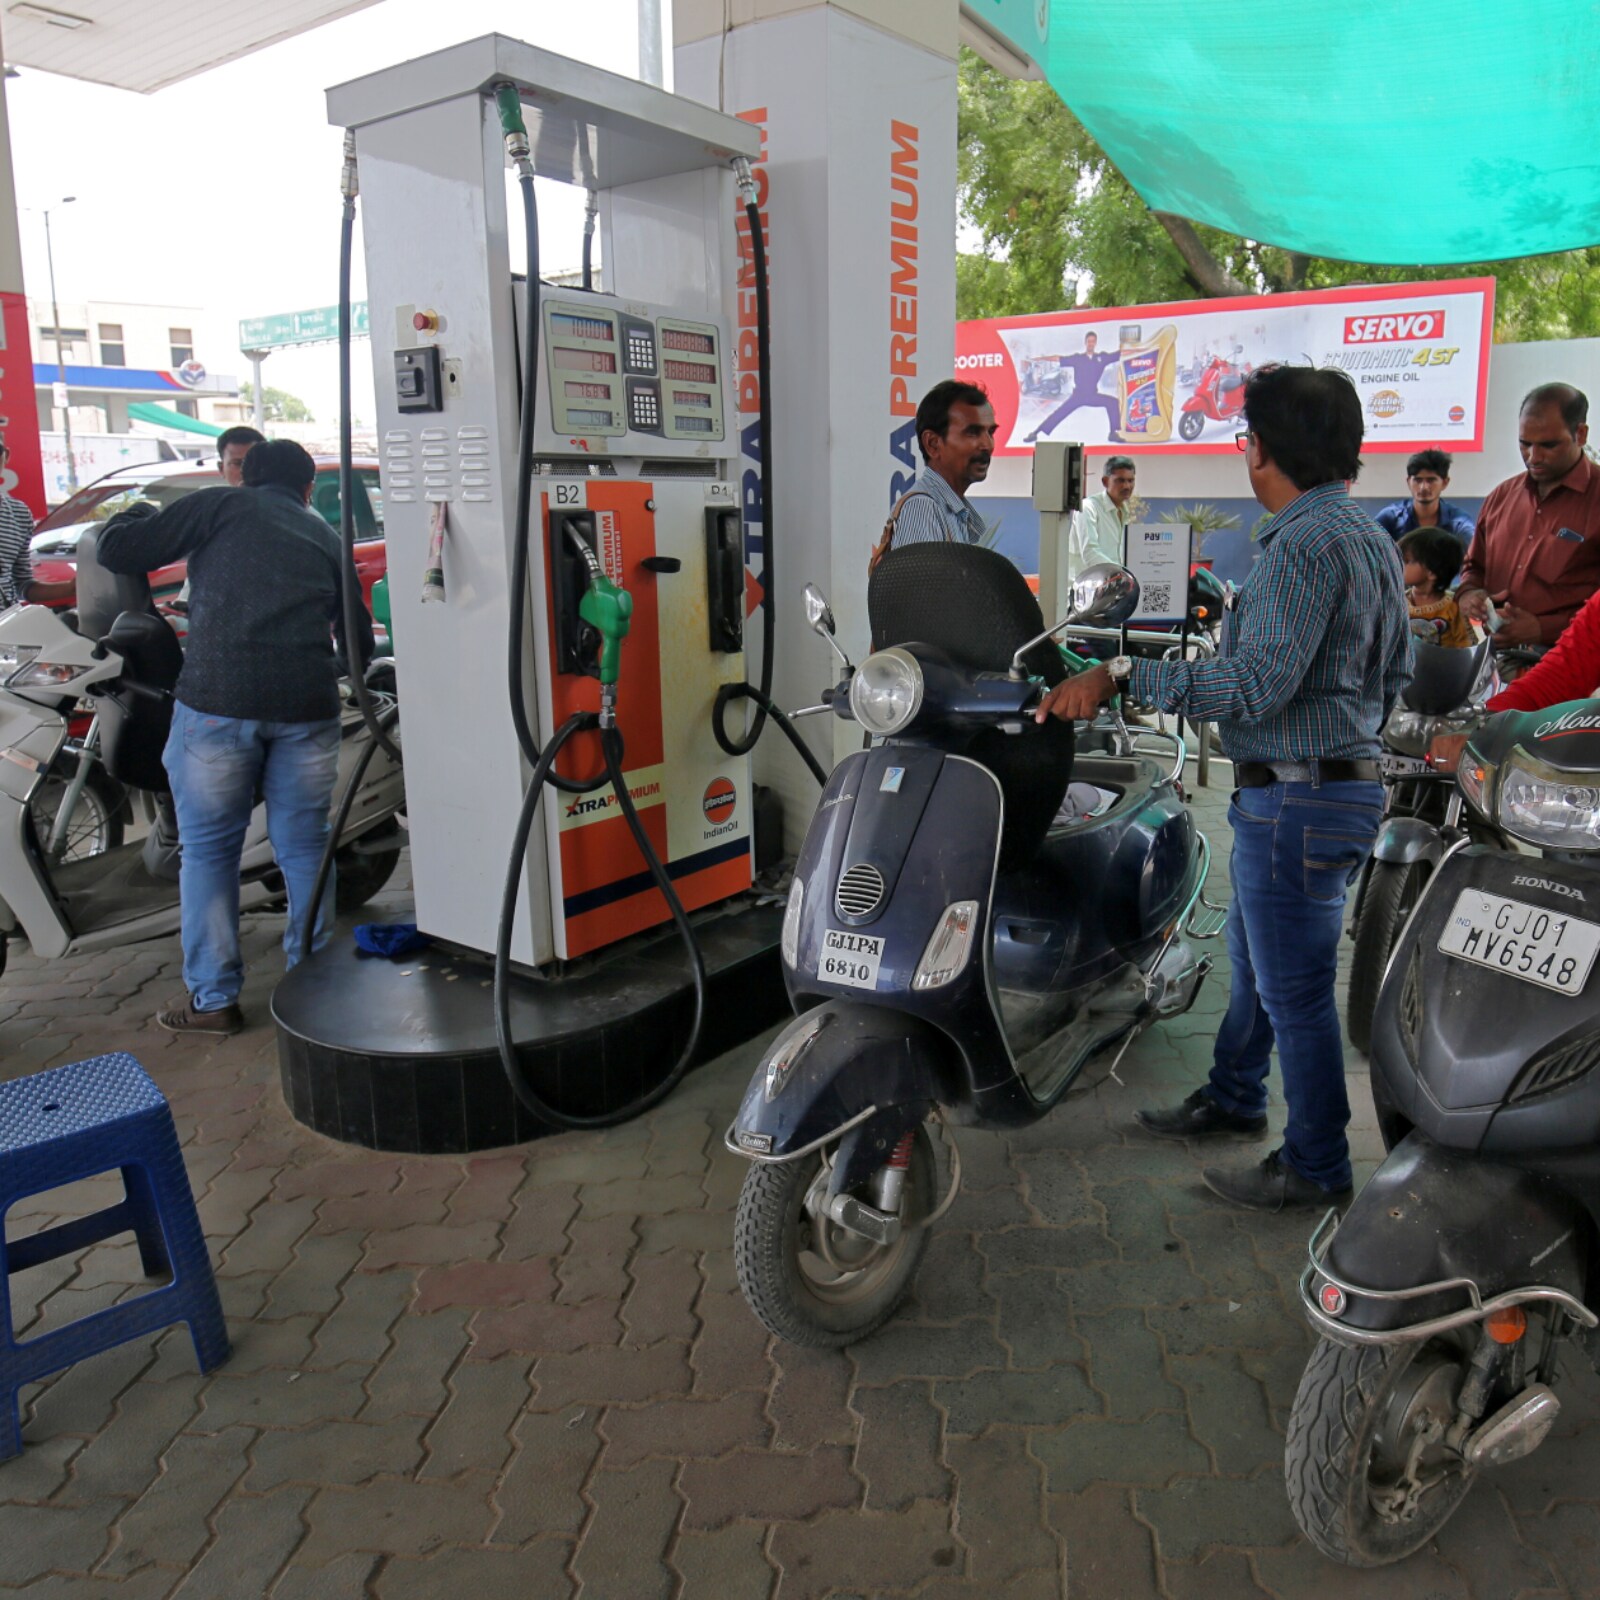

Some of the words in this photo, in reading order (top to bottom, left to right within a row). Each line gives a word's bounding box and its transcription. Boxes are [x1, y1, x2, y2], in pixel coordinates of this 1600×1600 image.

[1347, 313, 1435, 342] SERVO
[1361, 373, 1400, 384] ENGINE
[1402, 372, 1420, 382] OIL
[556, 485, 579, 504] B2
[602, 515, 614, 579] REMIUM
[565, 782, 660, 818] XTRAPMIUM
[704, 820, 738, 840] IndianOil
[1511, 875, 1586, 902] HONDA
[1456, 916, 1471, 927] IND
[825, 957, 870, 981] 6810
